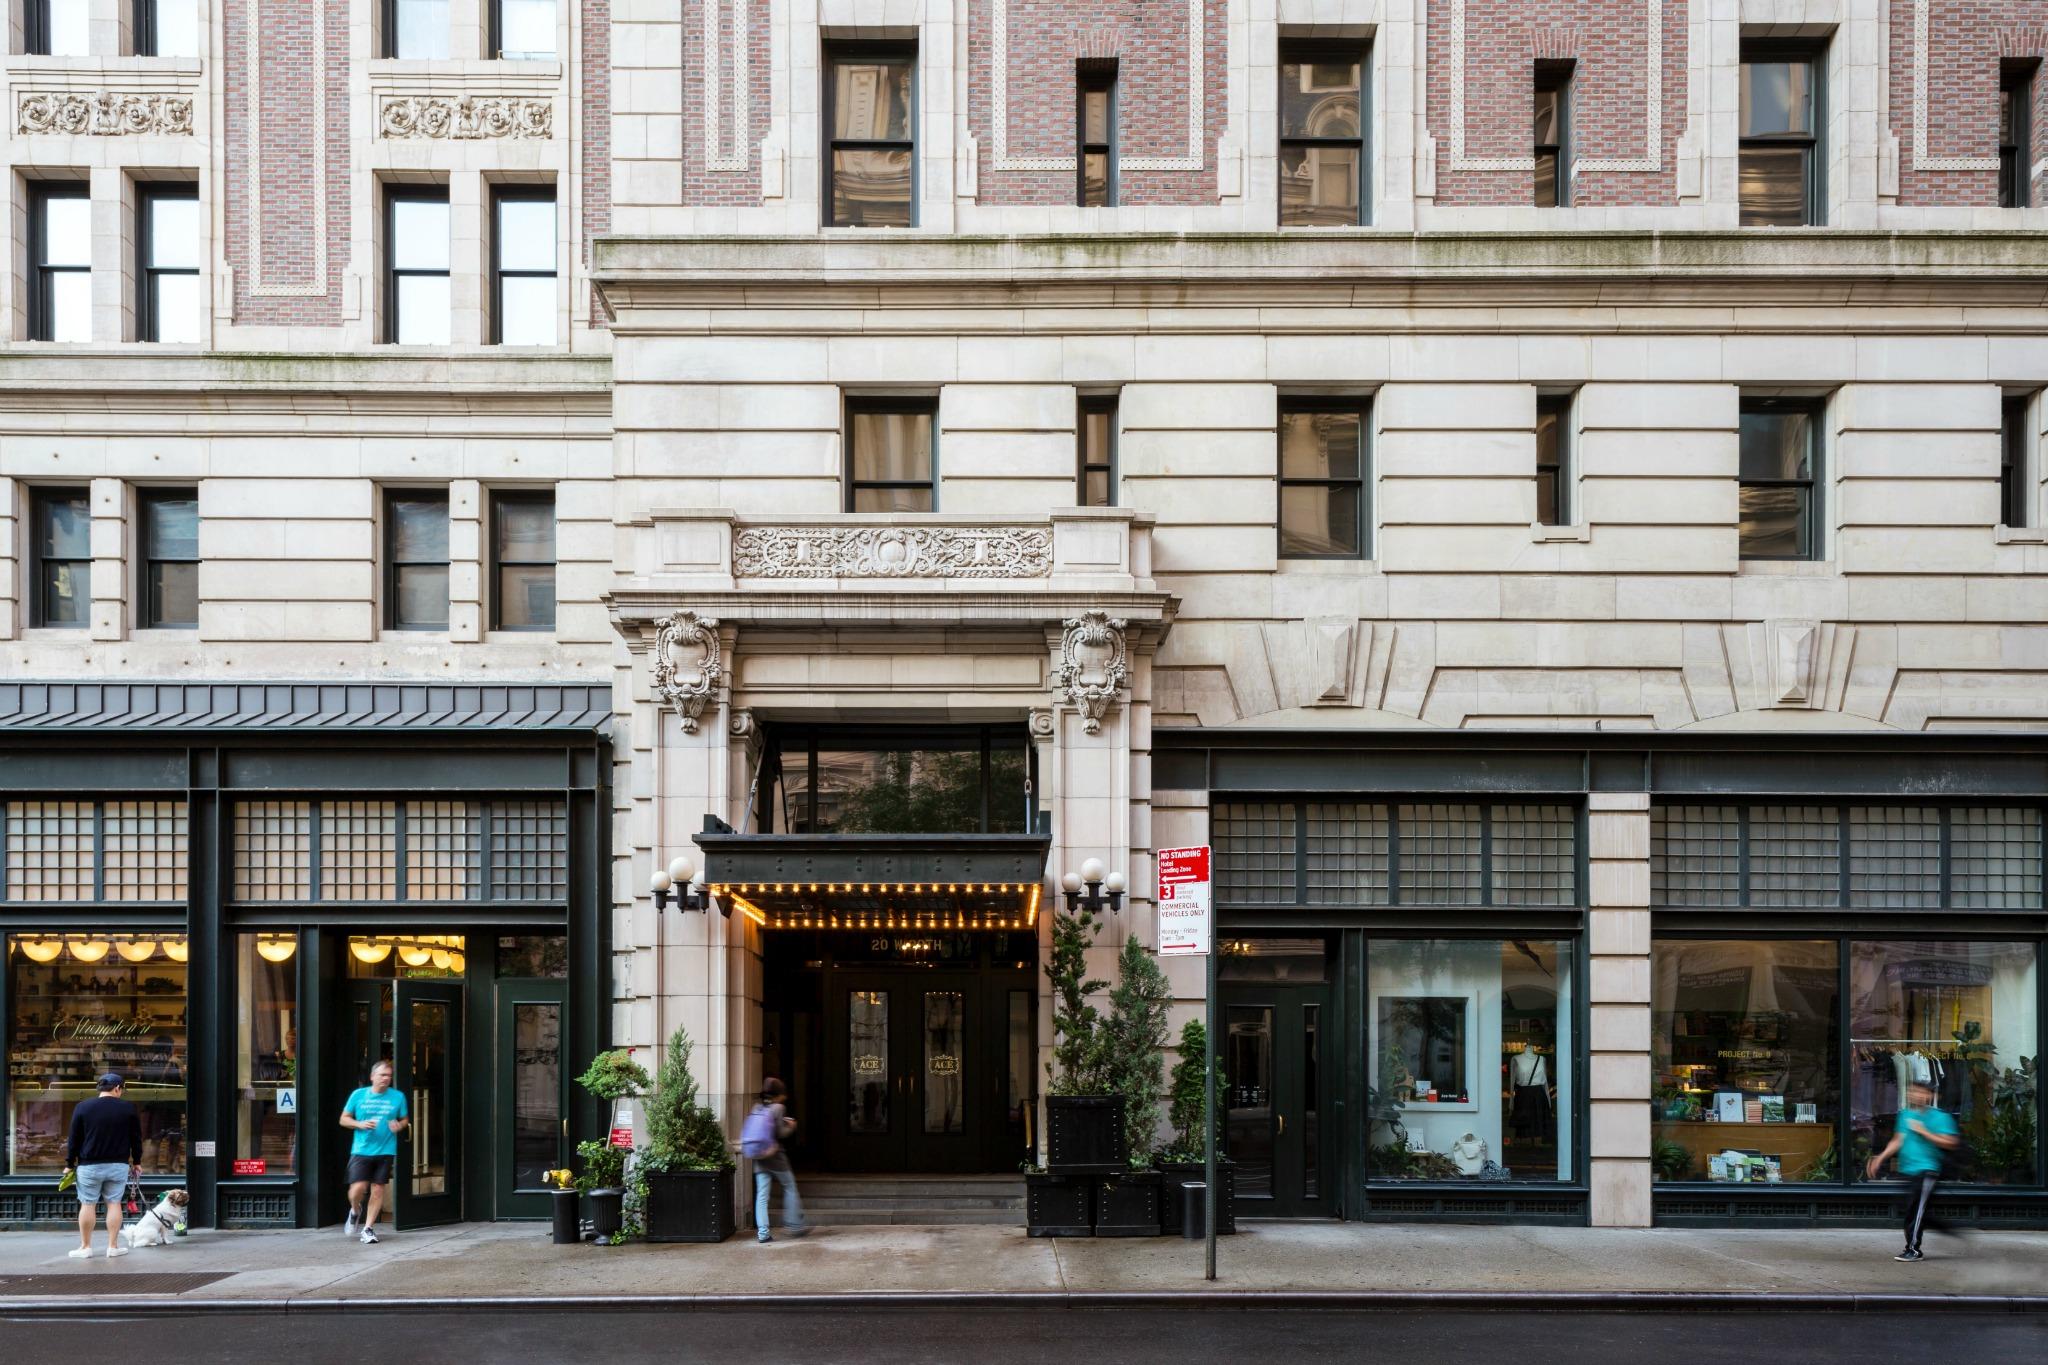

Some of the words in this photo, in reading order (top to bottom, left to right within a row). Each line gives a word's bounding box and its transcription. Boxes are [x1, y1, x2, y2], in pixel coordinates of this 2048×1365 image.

[1160, 852, 1170, 860] NO
[1170, 850, 1201, 859] STANDING
[1162, 885, 1172, 899] 3
[1161, 902, 1199, 910] COMMERCIAL
[1189, 909, 1205, 917] ONLY
[871, 939, 888, 951] 20
[1717, 1050, 1750, 1058] PROJECT
[860, 1060, 879, 1069] ACE
[934, 1060, 954, 1069] ACE
[280, 1091, 294, 1106] A
